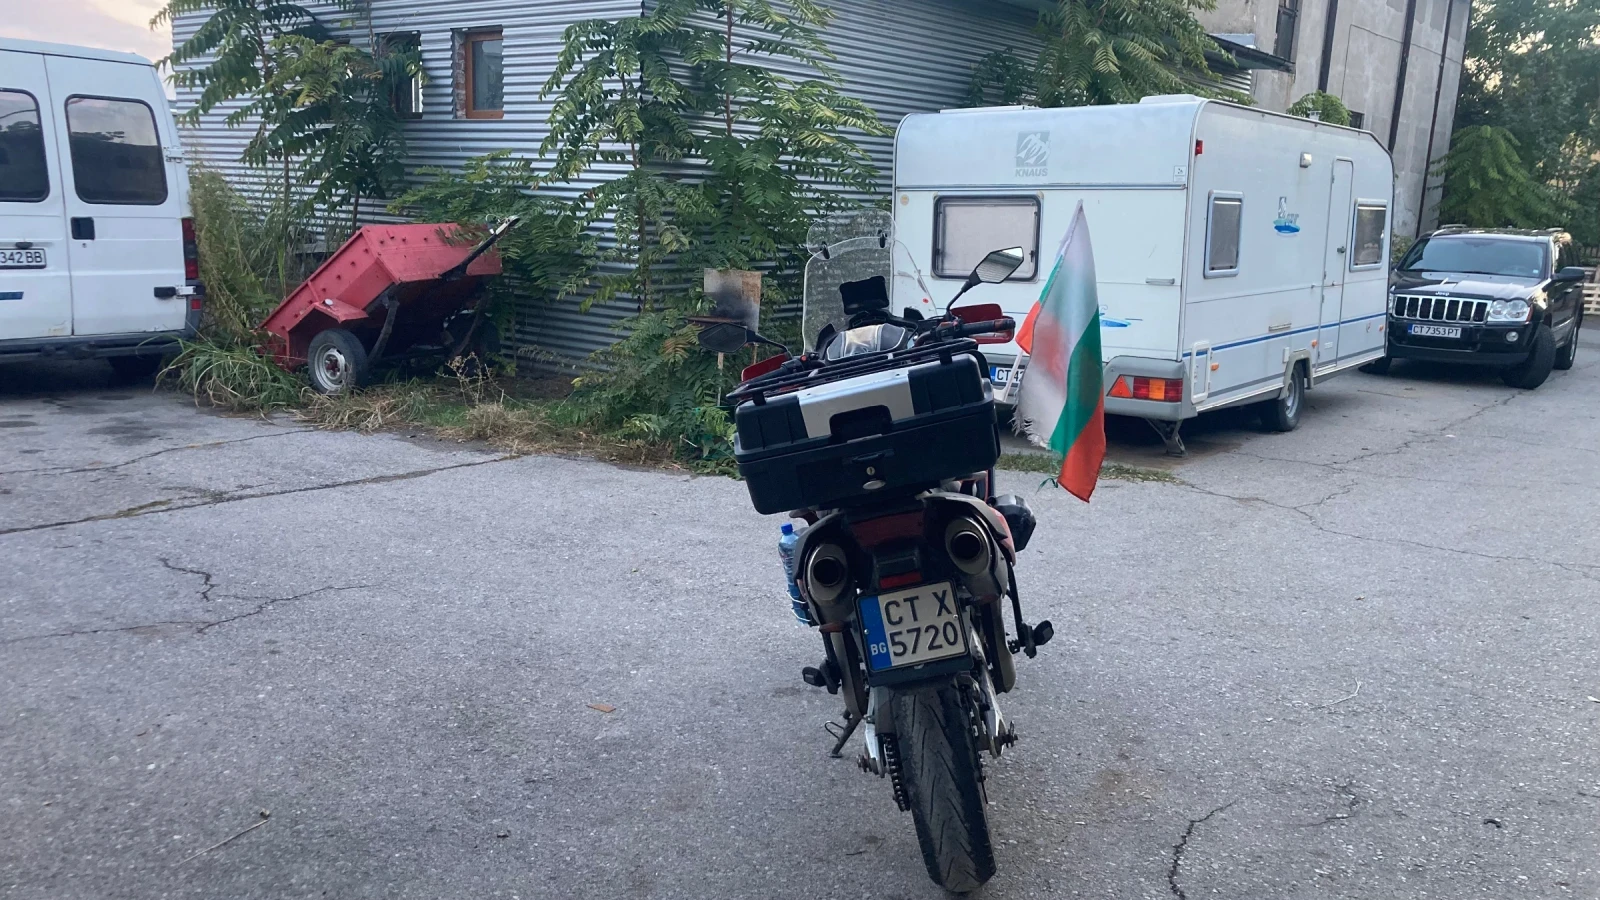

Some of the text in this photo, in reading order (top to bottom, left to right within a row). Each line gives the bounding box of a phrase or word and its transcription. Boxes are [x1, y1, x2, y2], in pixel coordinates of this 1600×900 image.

[1015, 168, 1049, 177] KNAUS
[0, 251, 43, 264] 342 BB
[1413, 325, 1460, 337] CT 7353 PT
[996, 369, 1012, 381] CT
[884, 590, 952, 626] CT X
[889, 621, 958, 657] 5720
[870, 642, 887, 656] BG
